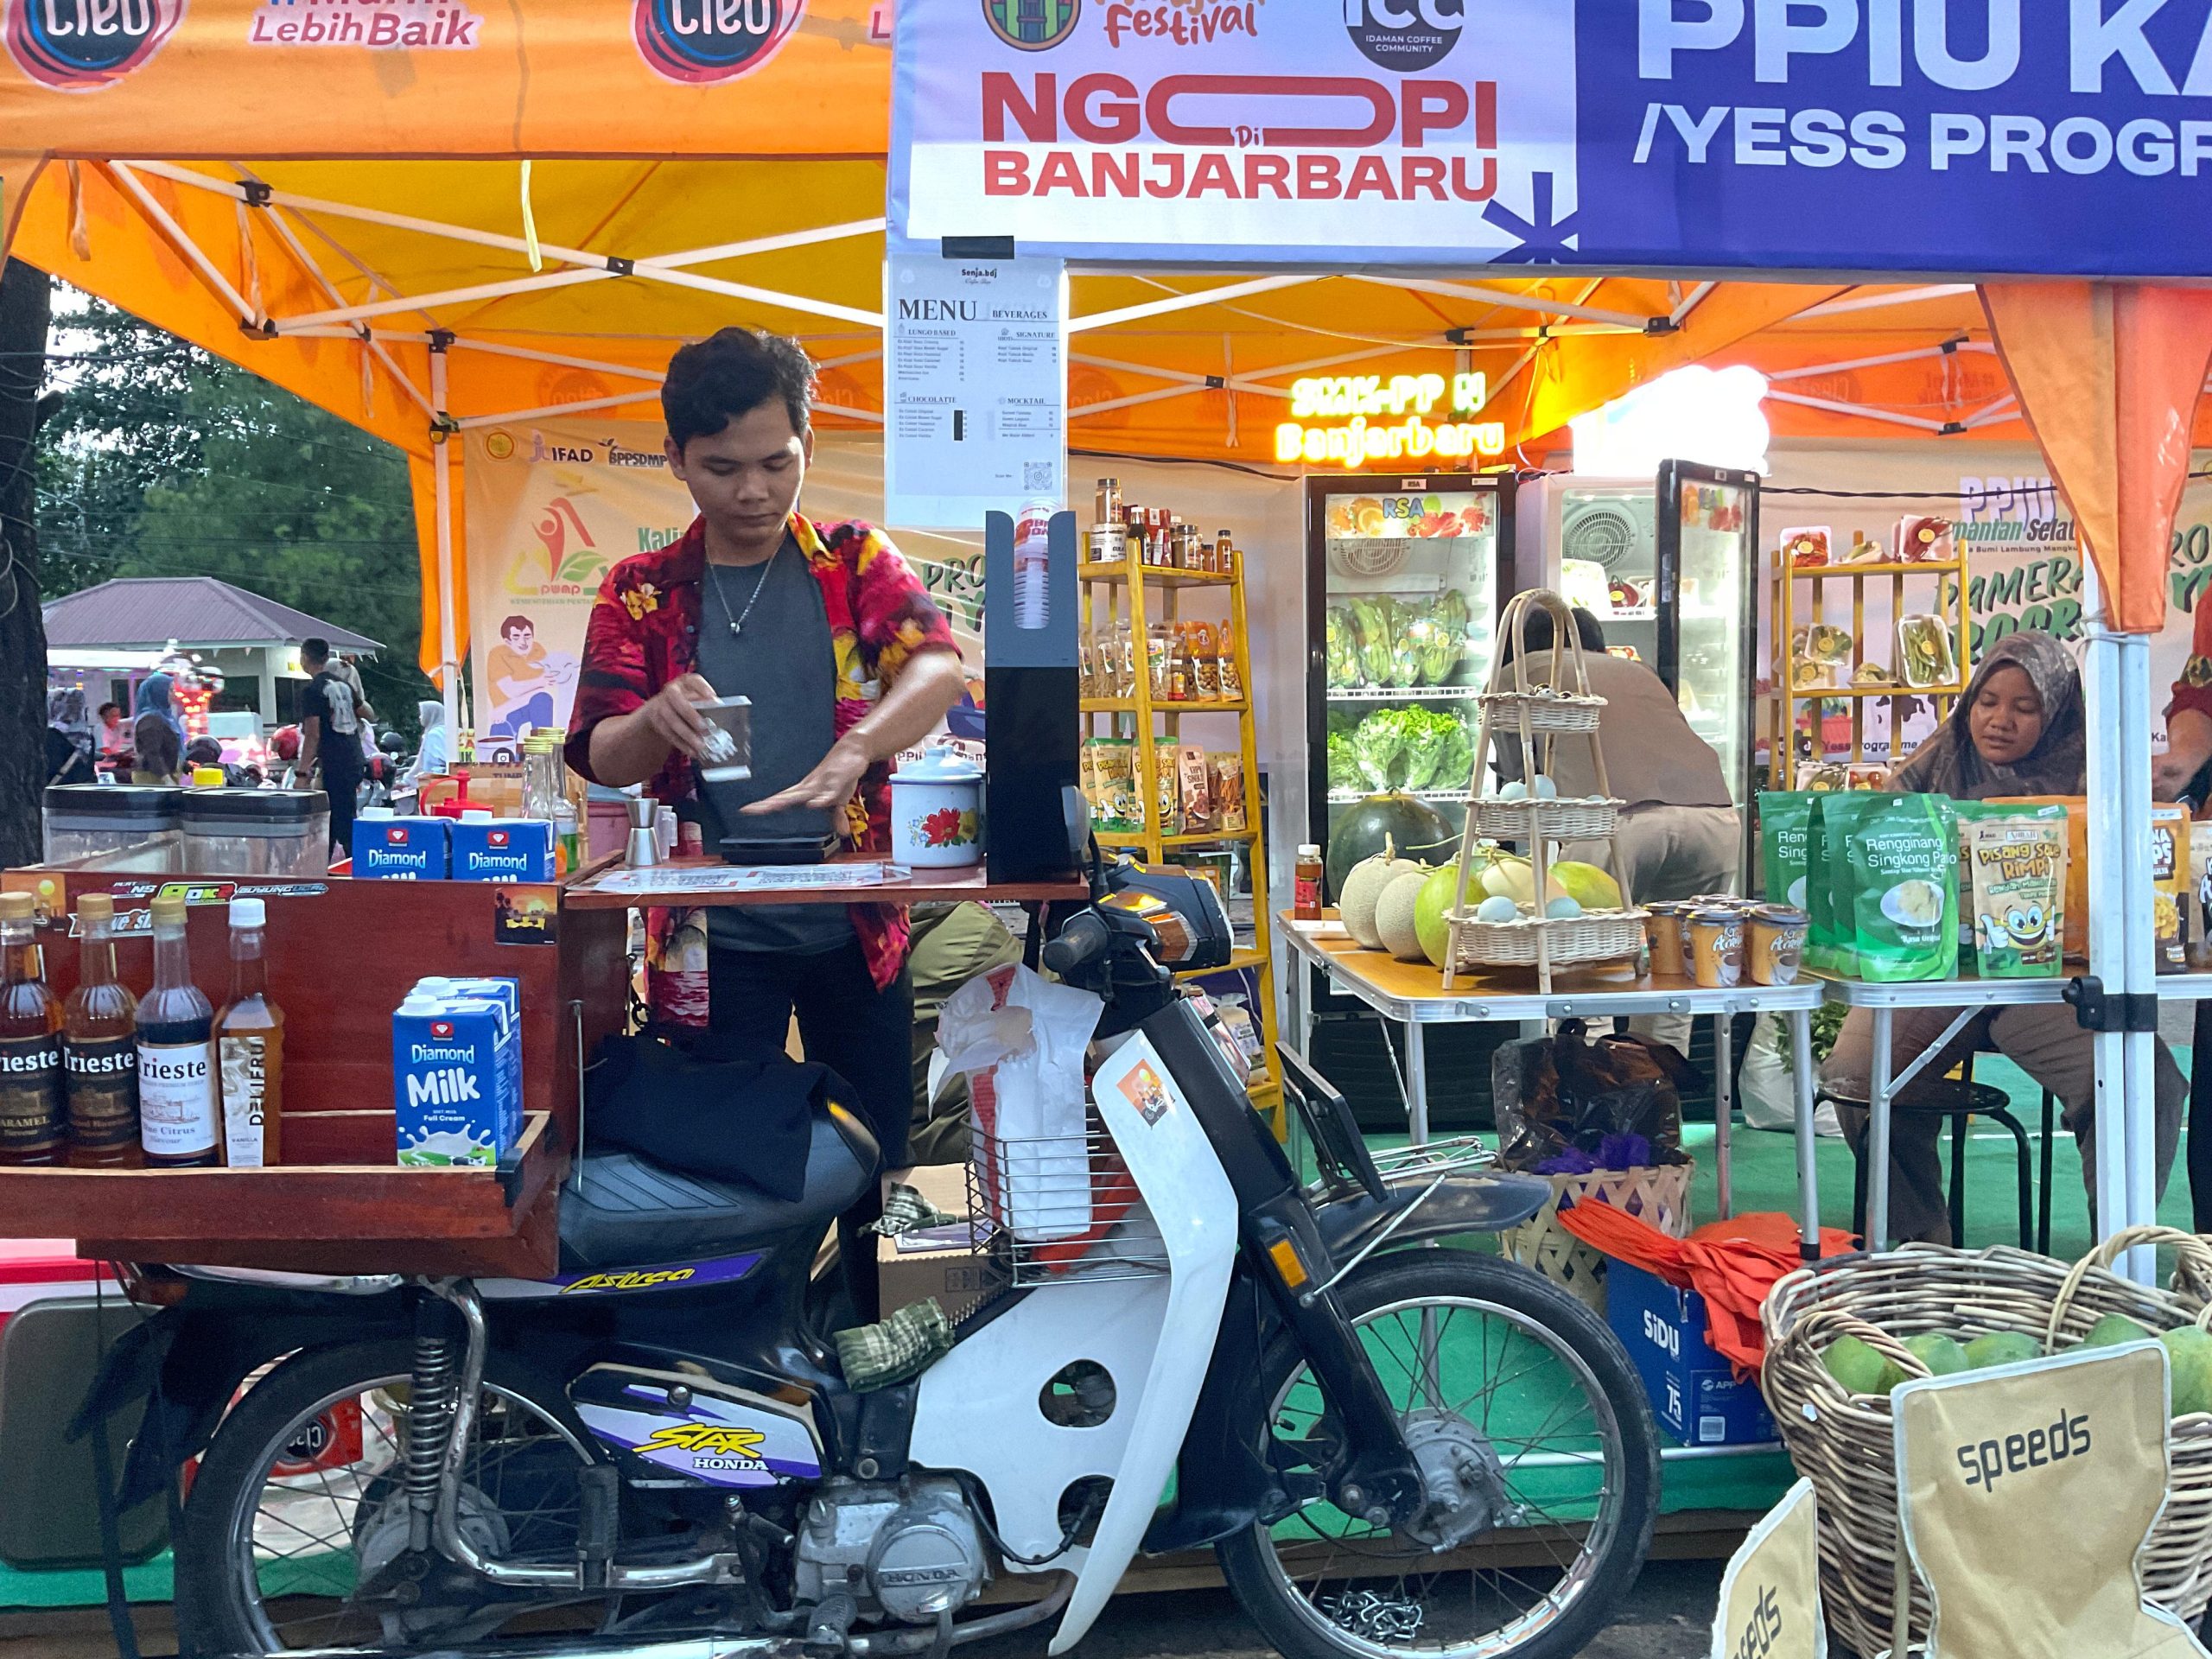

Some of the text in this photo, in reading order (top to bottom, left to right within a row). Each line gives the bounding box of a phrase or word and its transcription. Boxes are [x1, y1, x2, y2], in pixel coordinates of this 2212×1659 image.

[1365, 35, 1404, 43] IDAMAN
[1375, 44, 1433, 53] COMMUNITY
[982, 149, 1497, 201] BANJARBARU
[898, 298, 977, 321] MENU
[992, 309, 1048, 320] BEVERAGES
[1015, 331, 1056, 340] SIGNATURE
[551, 447, 594, 462] IFAD
[1382, 498, 1425, 519] RSA
[368, 849, 426, 869] Diamond
[469, 852, 527, 872] Diamond
[1868, 854, 1930, 869] Singkong
[411, 1044, 474, 1065] Diamond
[407, 1067, 481, 1108] Milk
[1666, 1383, 1683, 1422] 75
[632, 1422, 766, 1459] STAR
[1956, 1408, 2092, 1494] speeds
[693, 1457, 769, 1471] HONDA
[887, 1567, 962, 1584] HONDA
